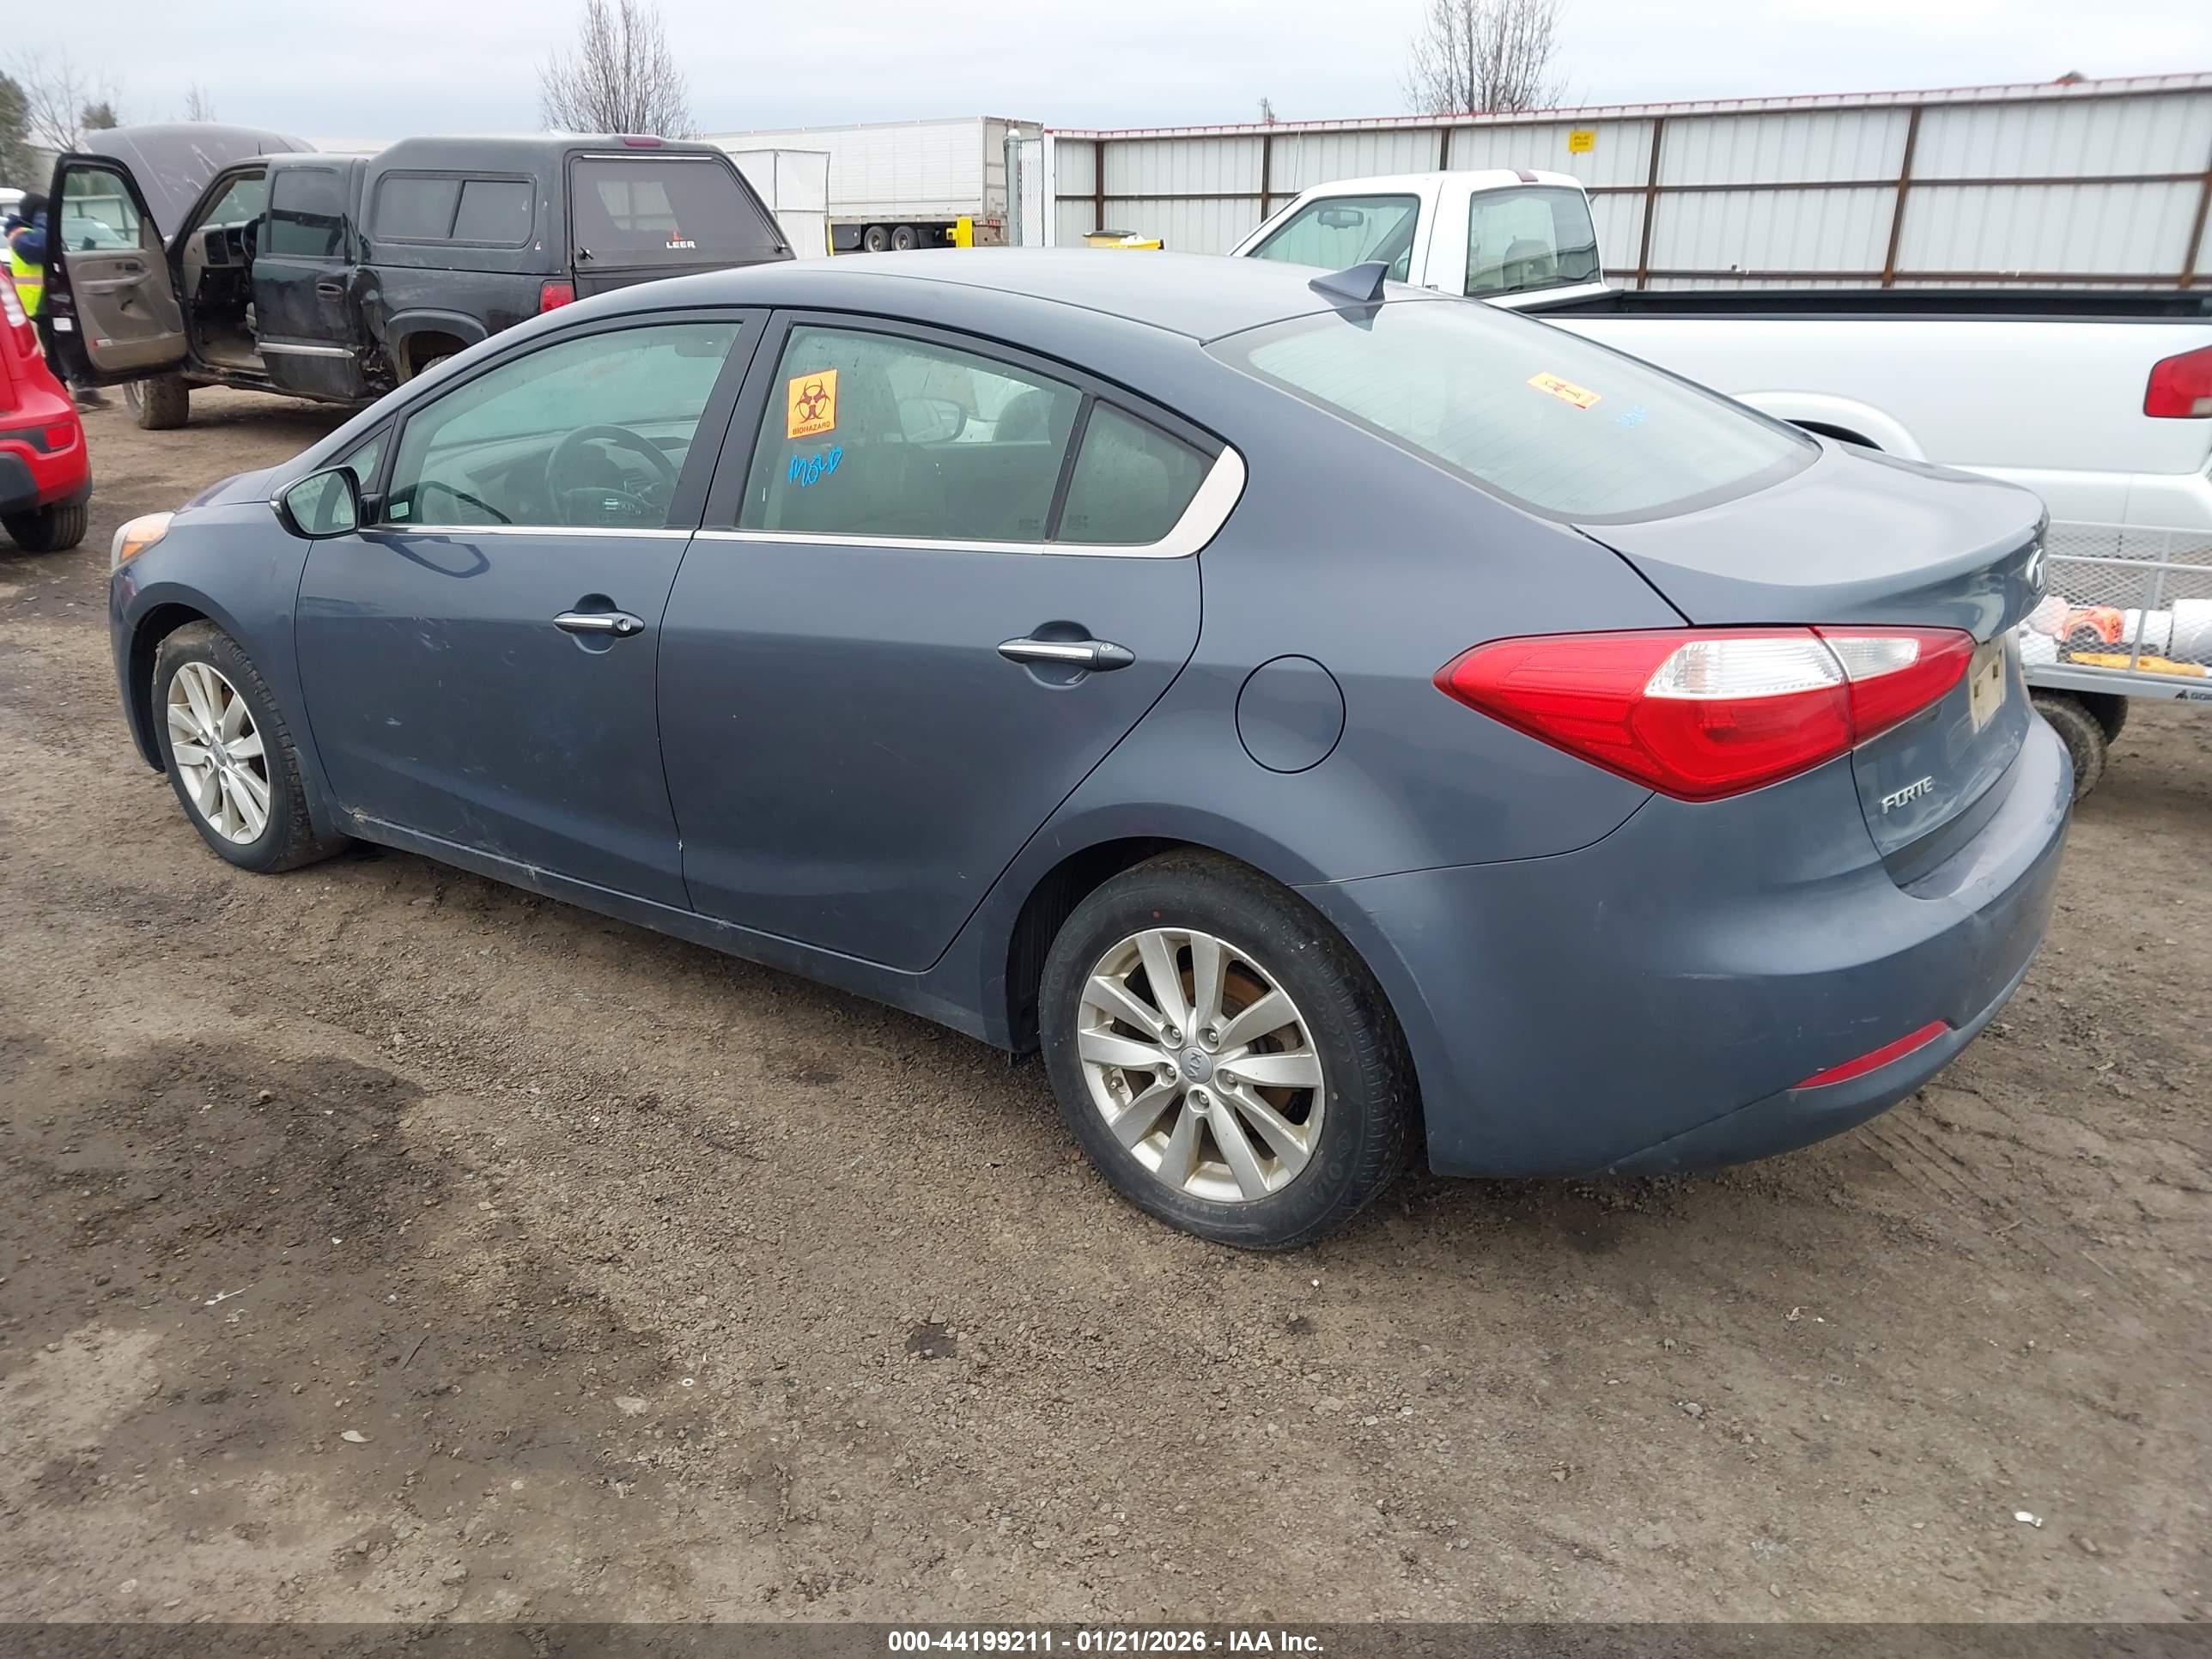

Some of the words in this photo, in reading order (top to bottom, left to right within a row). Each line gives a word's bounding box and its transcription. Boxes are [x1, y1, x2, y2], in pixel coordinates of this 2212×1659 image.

[665, 240, 696, 249] LEER
[793, 421, 830, 435] BIOHAZARD
[1881, 775, 1935, 815] FORTE
[1188, 1051, 1203, 1079] KIA
